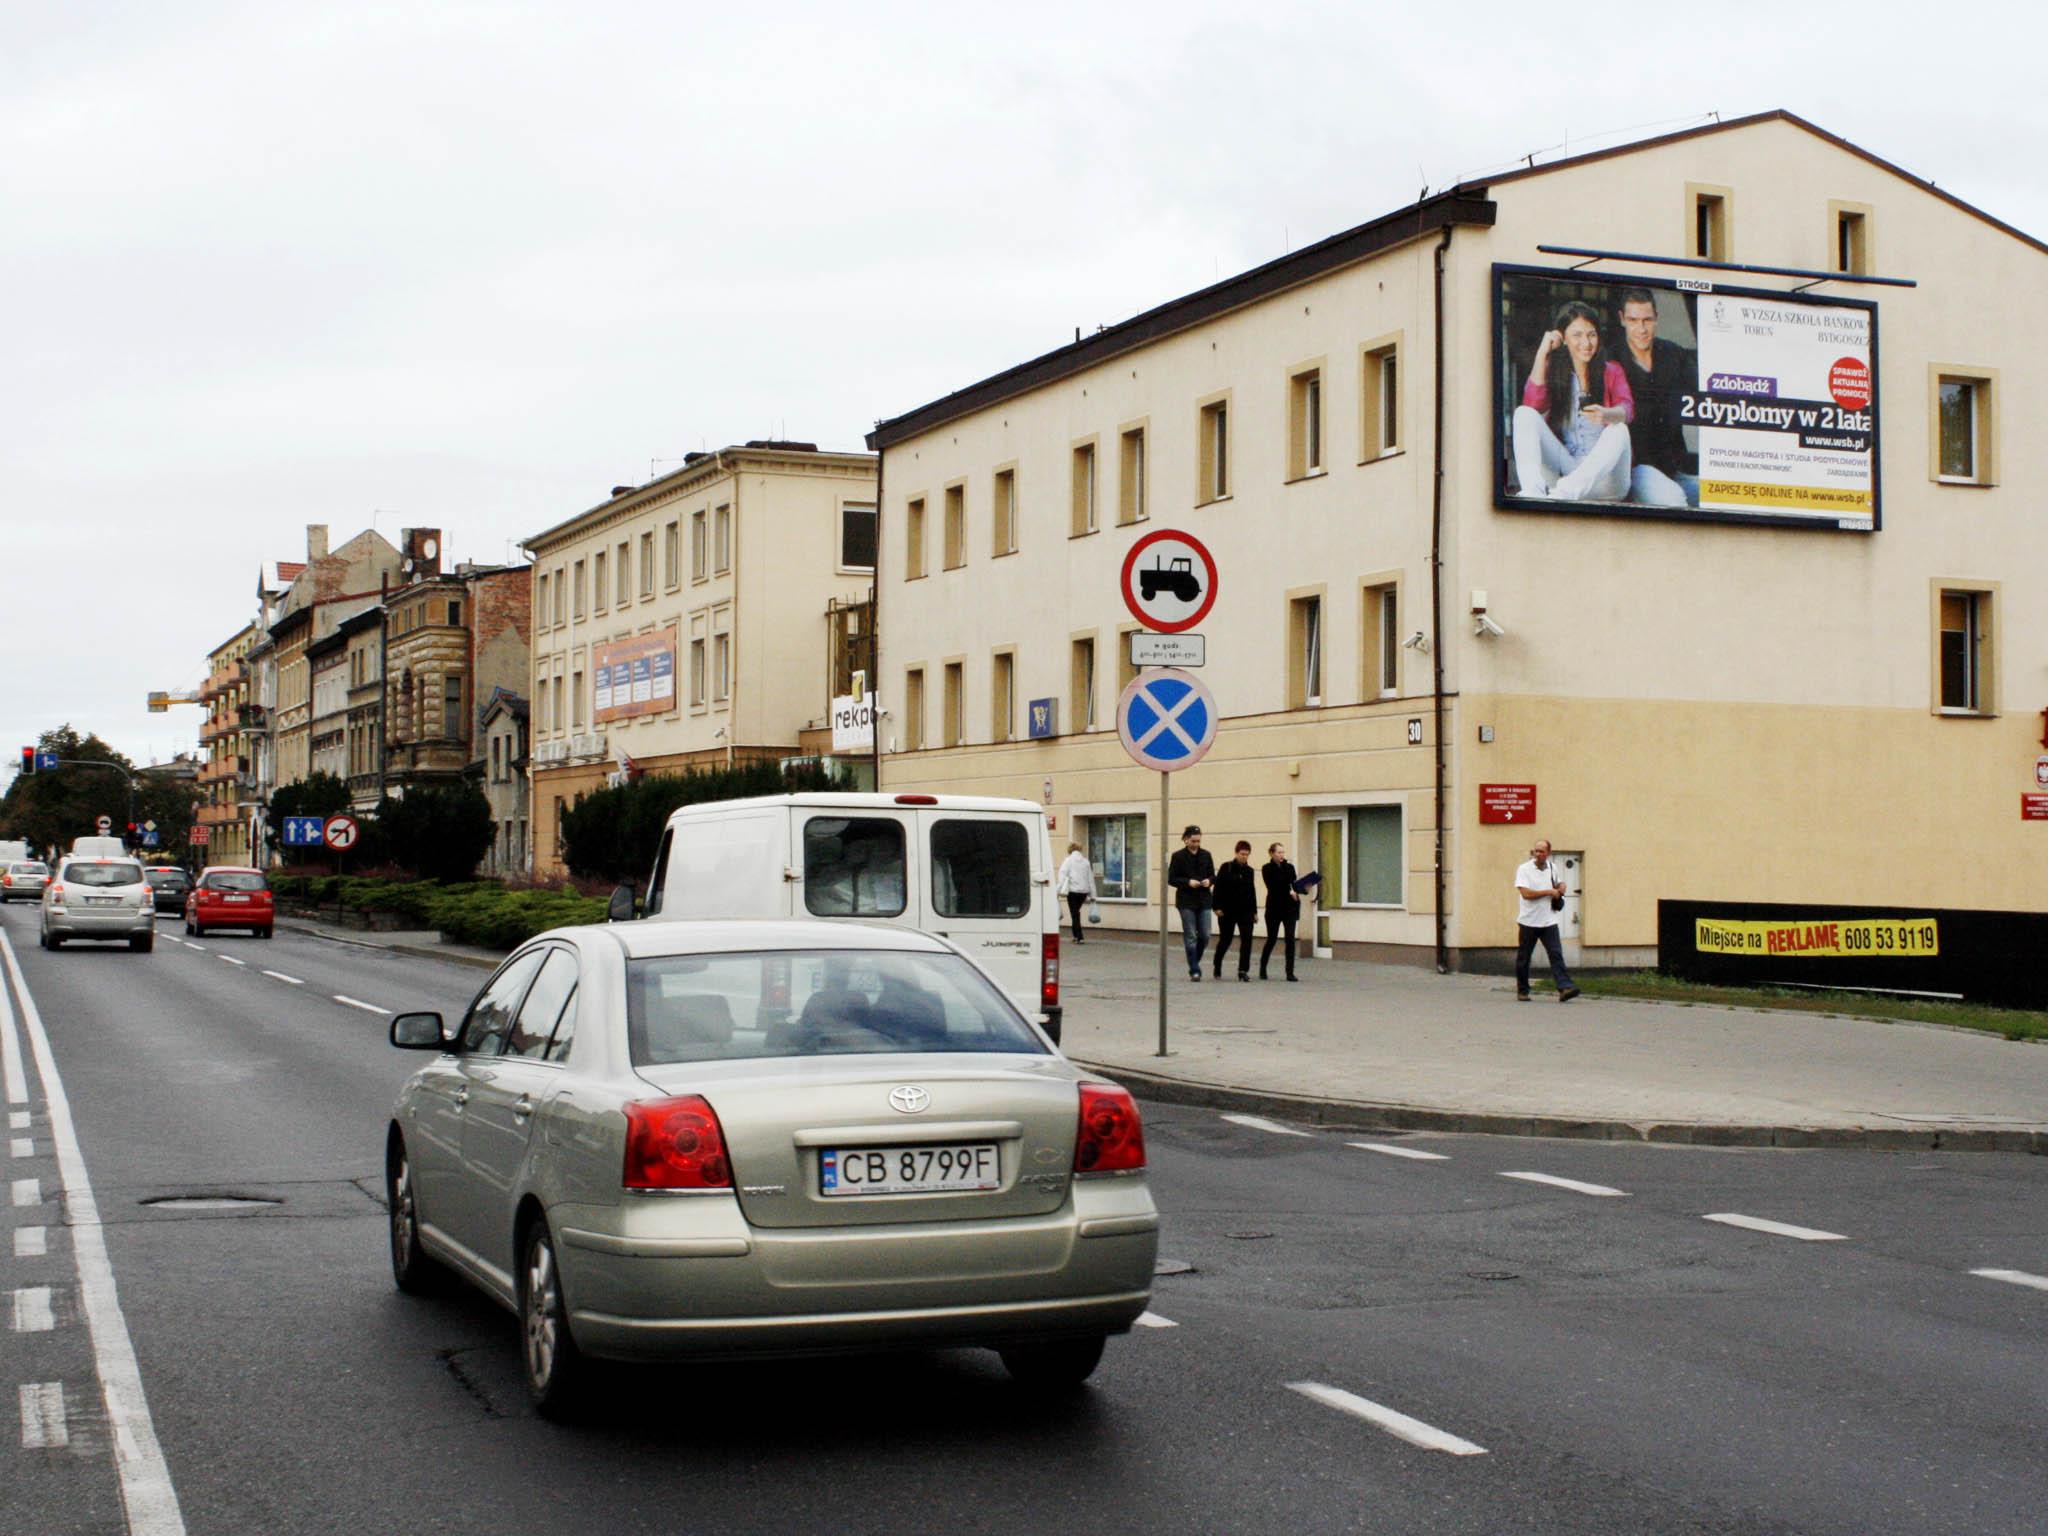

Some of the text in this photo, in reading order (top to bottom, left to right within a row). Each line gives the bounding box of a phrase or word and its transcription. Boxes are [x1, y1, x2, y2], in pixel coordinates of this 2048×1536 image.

[1743, 323, 1774, 337] TORUŃ
[1712, 377, 1770, 395] zdobądź
[1681, 395, 1695, 418] 2
[1698, 397, 1795, 429] dyplomy
[1798, 413, 1817, 428] w
[1820, 407, 1834, 429] 2
[1805, 435, 1865, 449] www.wsb.pl
[1708, 484, 1865, 505] ZAPISZ SIĘ ONLINE NA www.wsb.pl
[1409, 721, 1421, 742] 30
[1699, 926, 1744, 951] Miejsce
[1747, 933, 1762, 948] na
[1766, 923, 1841, 953] REKLAMĘ
[1844, 927, 1871, 950] 608
[1875, 927, 1894, 950] 53
[842, 1147, 993, 1185] CB 8799F
